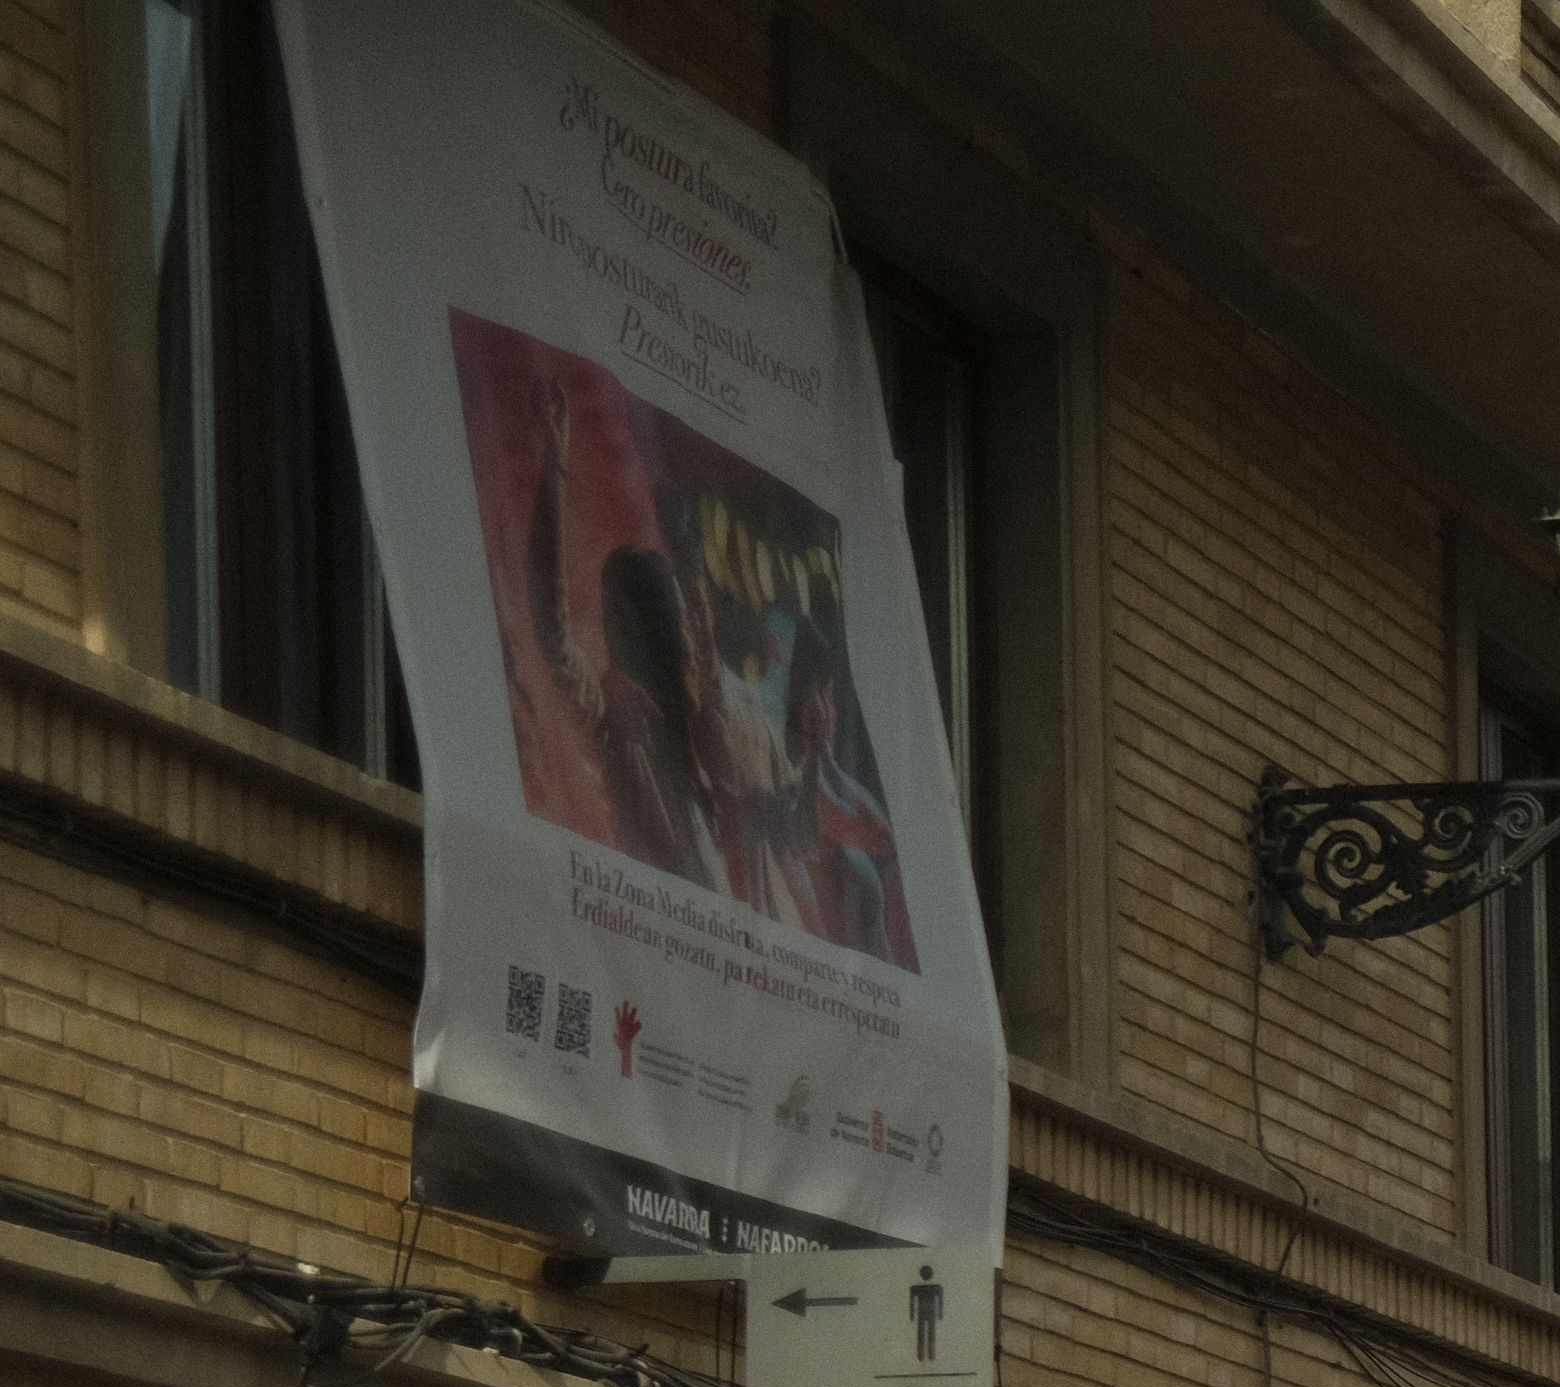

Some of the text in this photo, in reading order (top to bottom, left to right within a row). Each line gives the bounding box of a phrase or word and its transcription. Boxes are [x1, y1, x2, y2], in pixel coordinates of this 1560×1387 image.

[604, 113, 695, 194] postura
[614, 869, 655, 912] Zona
[626, 1184, 712, 1242] NAVARRA
